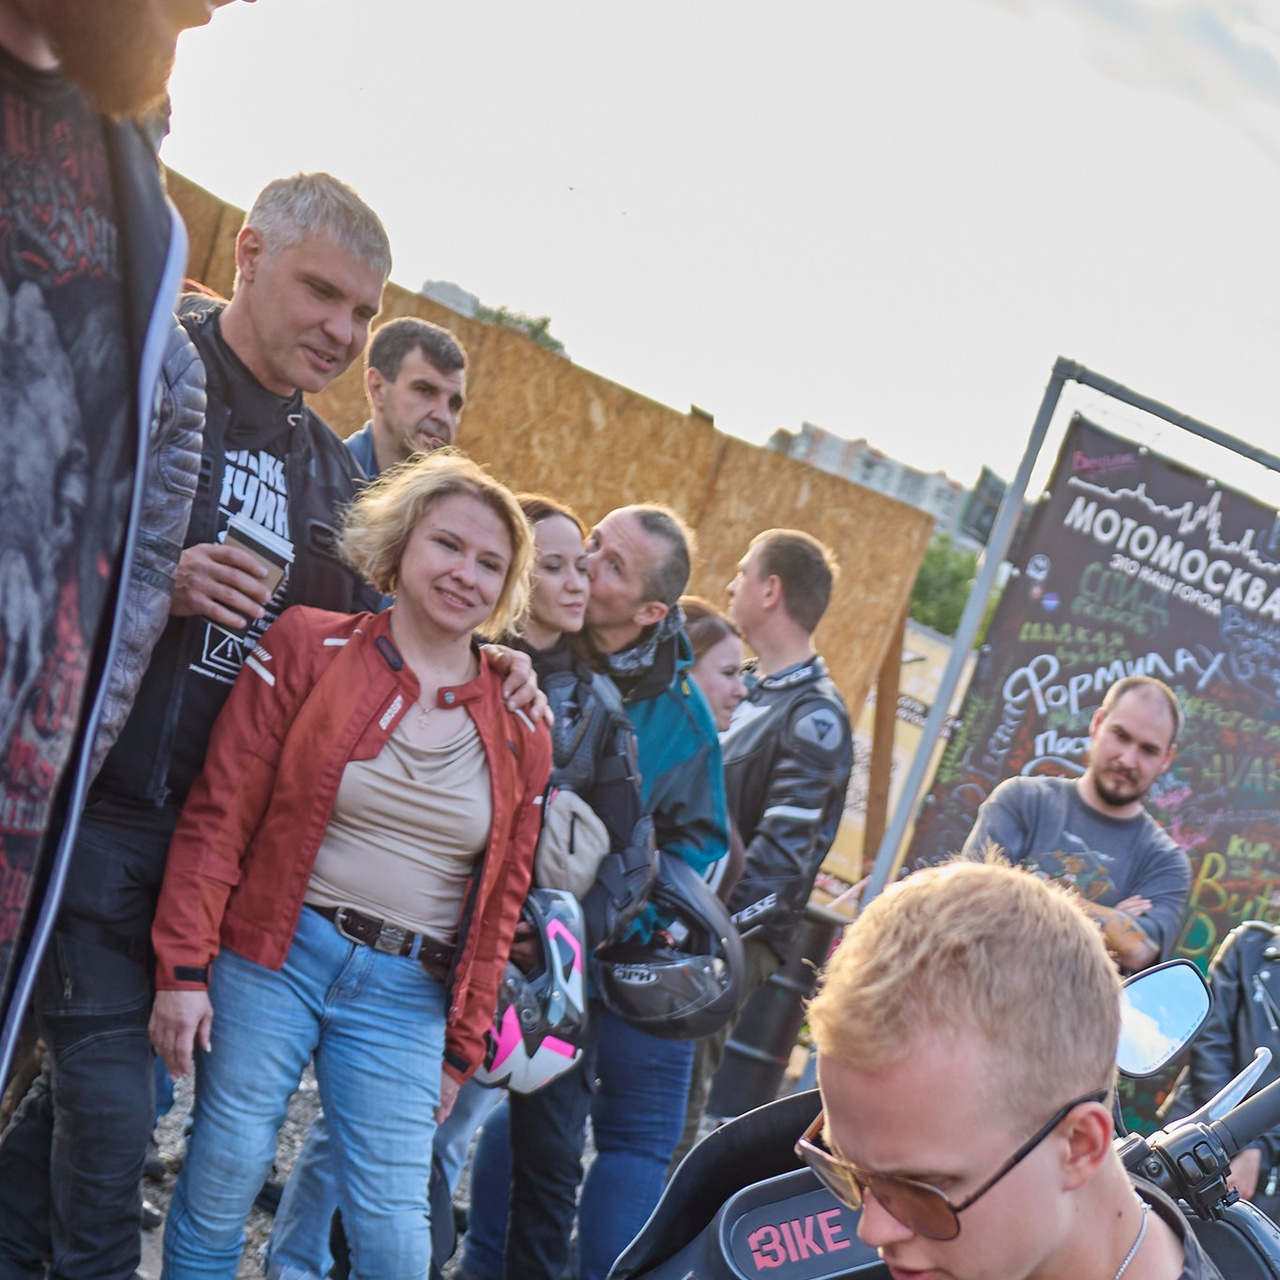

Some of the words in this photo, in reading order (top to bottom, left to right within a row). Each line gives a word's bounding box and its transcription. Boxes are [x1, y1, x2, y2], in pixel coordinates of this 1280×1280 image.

[1108, 553, 1140, 576] ЭТО
[1137, 565, 1175, 593] НАШ
[1172, 581, 1222, 616] ГОРОД
